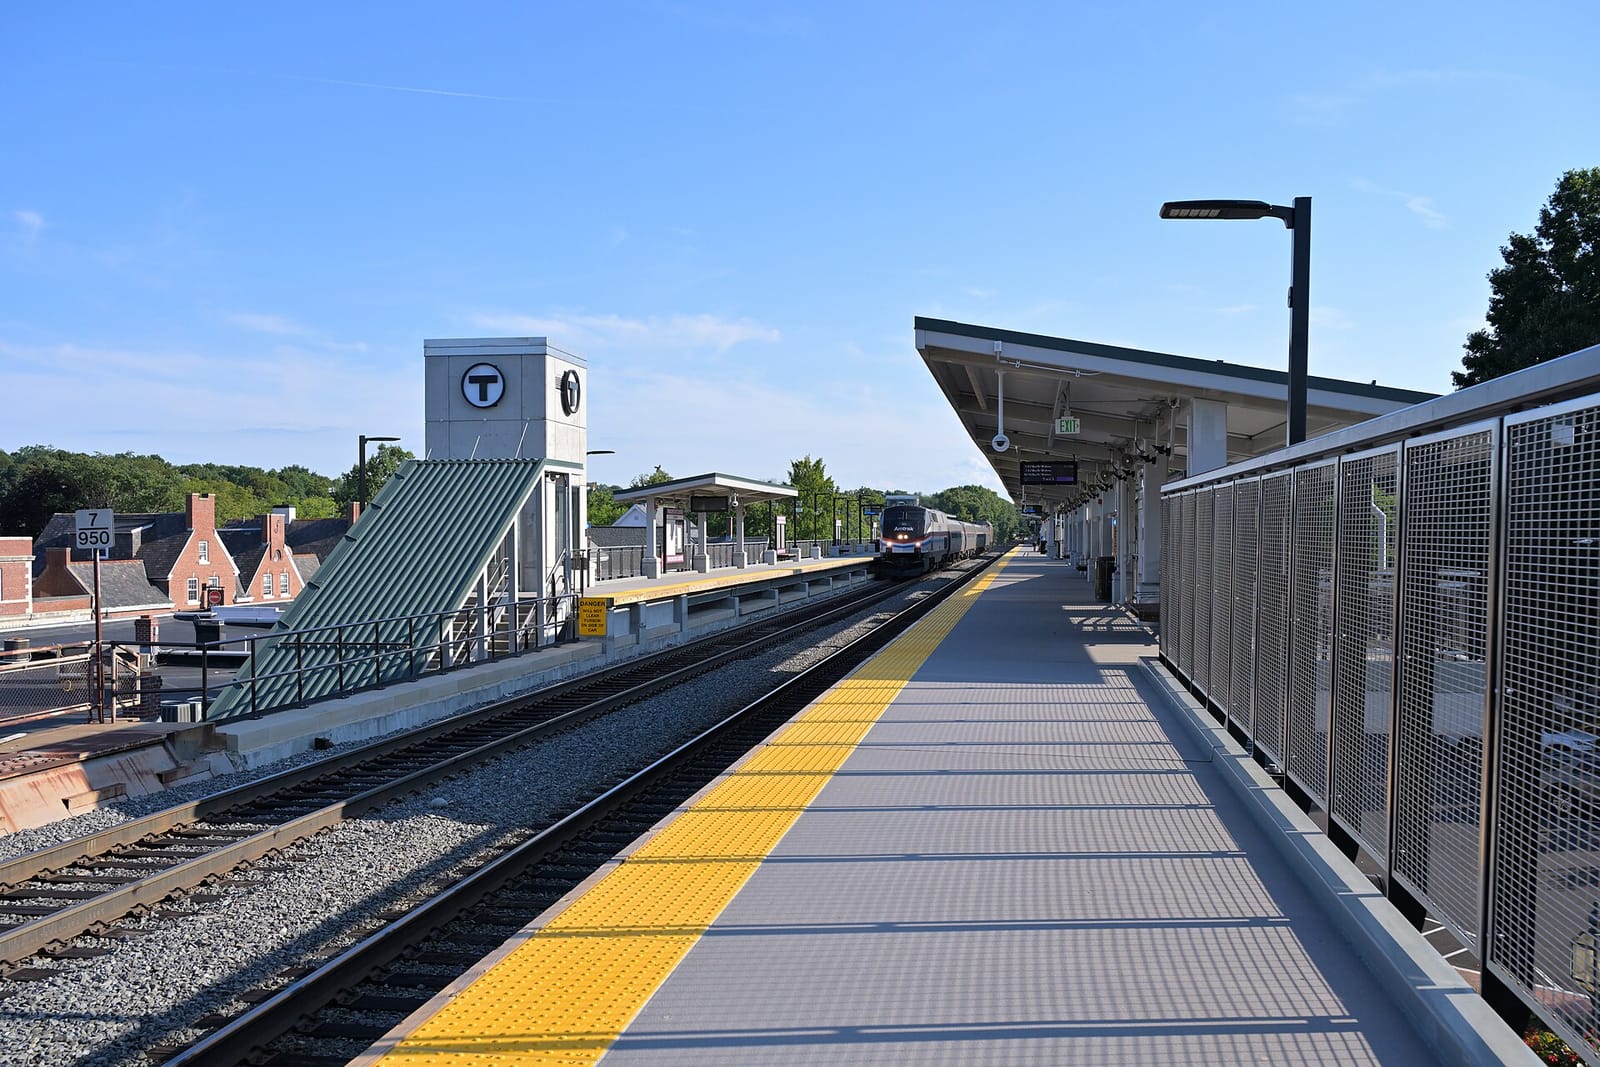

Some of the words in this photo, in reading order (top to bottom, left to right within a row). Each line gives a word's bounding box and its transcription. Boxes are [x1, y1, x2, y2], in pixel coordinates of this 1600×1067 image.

[468, 375, 498, 401] T
[568, 381, 578, 406] T
[1060, 419, 1077, 433] EXIT
[89, 513, 98, 526] 7
[78, 531, 109, 545] 950
